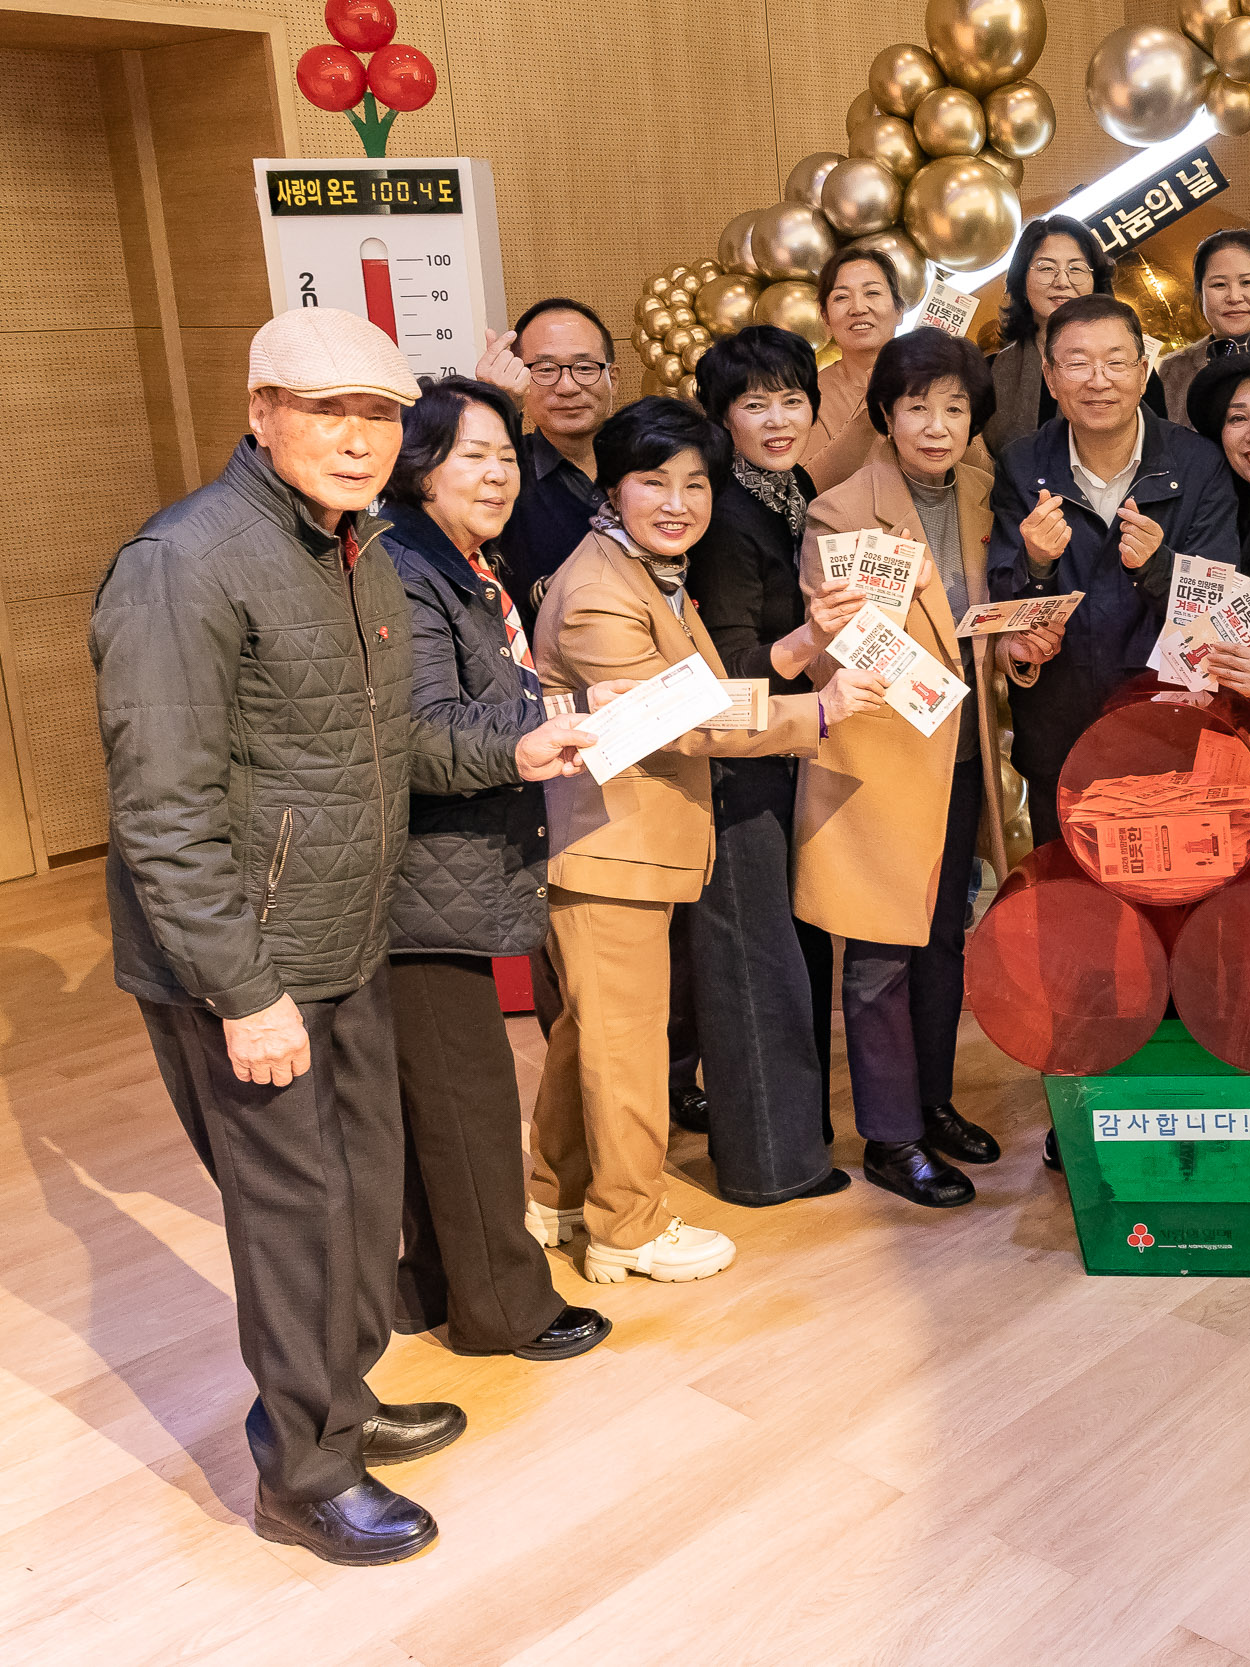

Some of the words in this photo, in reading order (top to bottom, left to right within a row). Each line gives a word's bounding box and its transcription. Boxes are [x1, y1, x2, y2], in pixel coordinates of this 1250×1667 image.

[278, 179, 322, 206] 사랑의
[327, 178, 358, 205] 온도
[1091, 180, 1183, 252] 나눔의
[1176, 158, 1217, 199] 날
[426, 254, 451, 266] 100
[432, 290, 448, 301] 90
[923, 313, 959, 336] 겨울나기
[927, 303, 964, 327] 따뜻한
[436, 328, 452, 340] 80
[830, 555, 848, 563] 2026
[864, 552, 881, 561] 2026
[860, 560, 909, 582] 따뜻한
[1180, 577, 1196, 585] 2026
[857, 574, 905, 593] 겨울나기
[1177, 585, 1223, 605] 따뜻한
[1176, 600, 1210, 613] 겨울나
[856, 628, 896, 670] 따뜻한
[1127, 827, 1144, 874] 따뜻한
[1098, 1113, 1248, 1137] 감사합니다!
